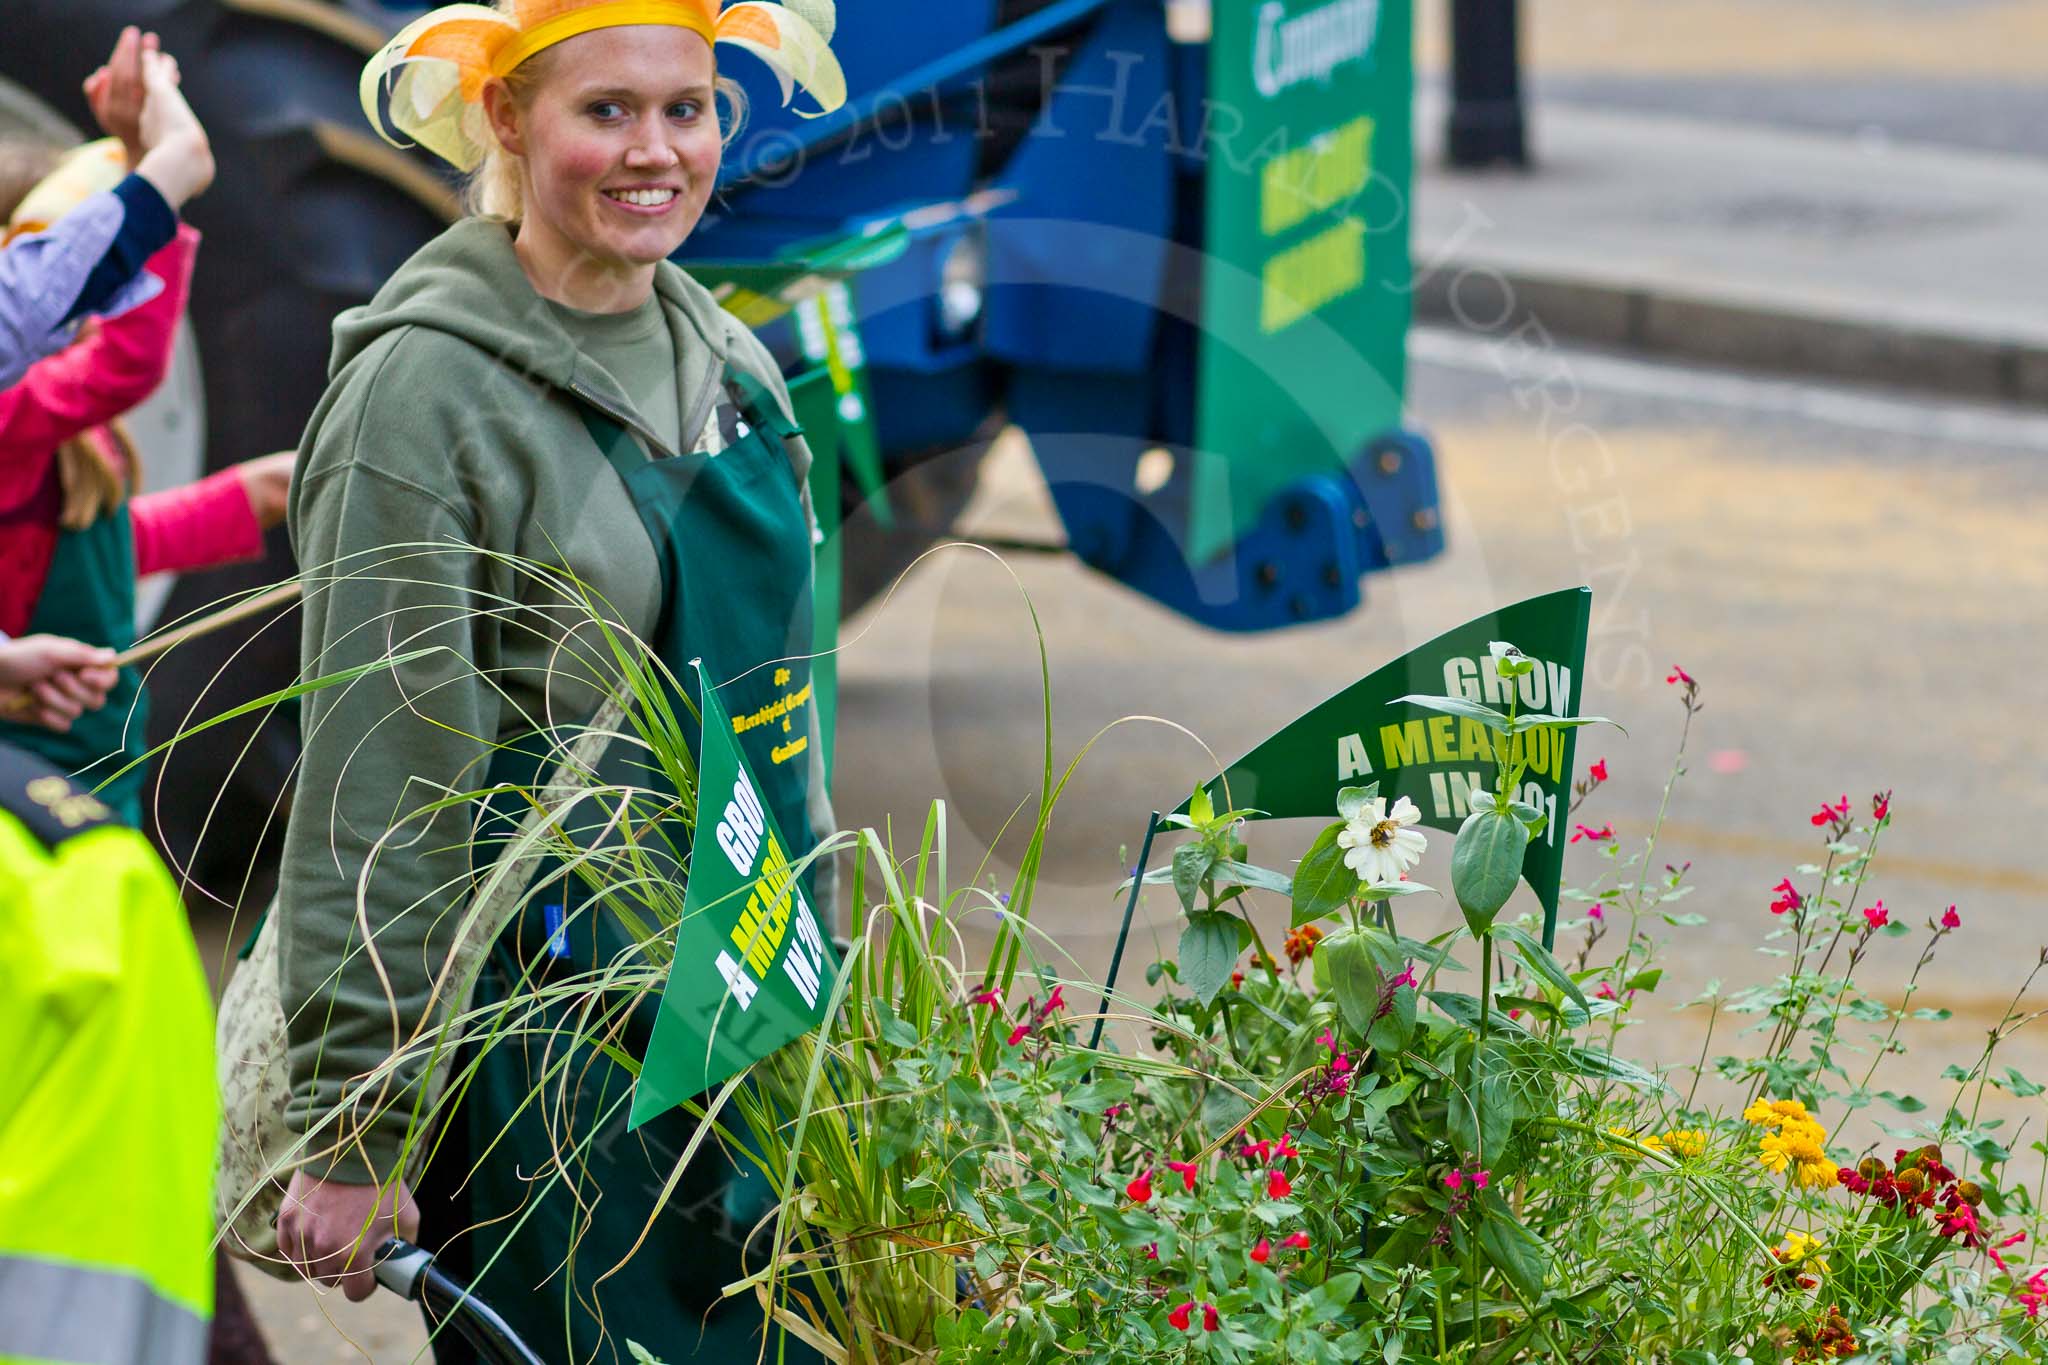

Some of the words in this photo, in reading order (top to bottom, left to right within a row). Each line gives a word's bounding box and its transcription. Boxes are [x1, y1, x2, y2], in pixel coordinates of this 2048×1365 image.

[1338, 733, 1374, 781] A
[1429, 771, 1484, 819] IN
[714, 949, 759, 1013] A
[782, 937, 820, 1011] IN
